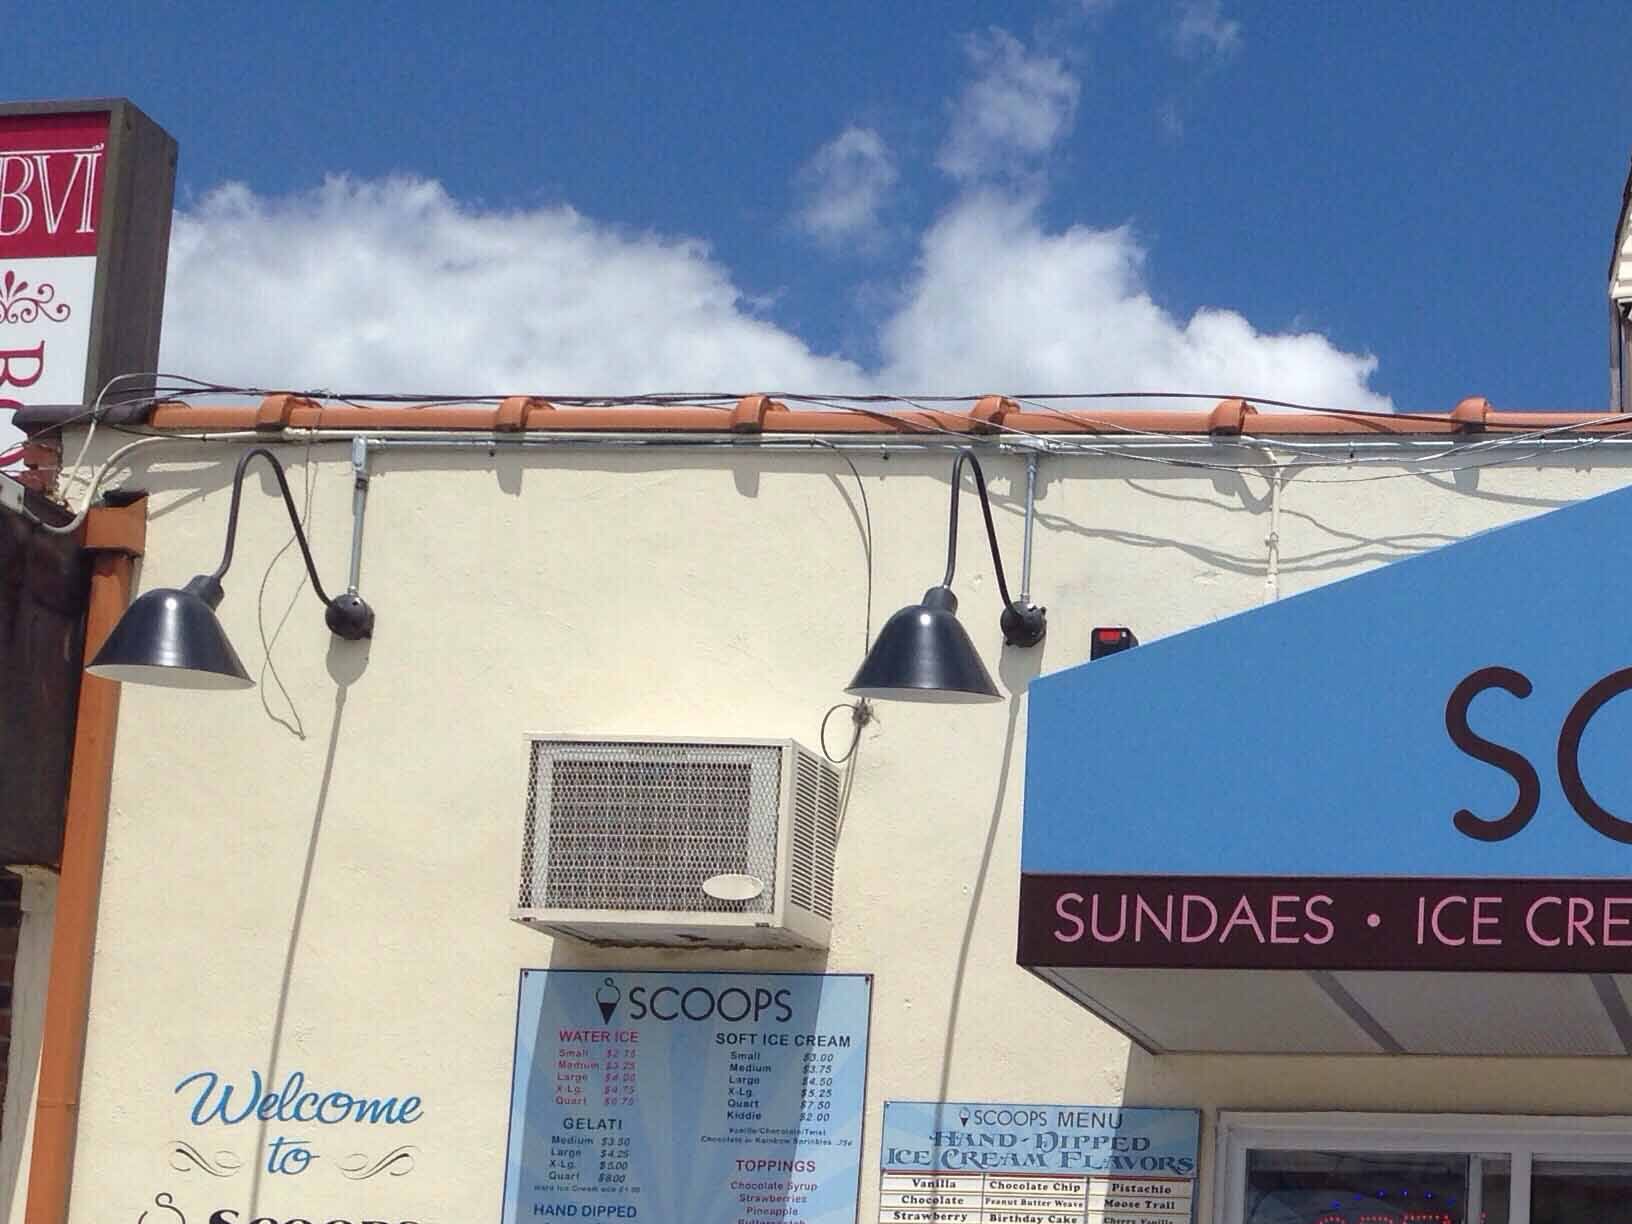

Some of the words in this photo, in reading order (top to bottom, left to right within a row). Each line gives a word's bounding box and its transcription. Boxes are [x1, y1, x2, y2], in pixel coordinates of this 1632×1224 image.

[1053, 892, 1336, 947] SUNDAES
[1418, 896, 1502, 947] ICE
[629, 986, 793, 1023] SCOOPS
[559, 1029, 611, 1043] WATER
[614, 1030, 641, 1044] ICE
[715, 1032, 759, 1046] SOFT
[762, 1033, 790, 1047] ICE
[794, 1034, 852, 1049] CREAM
[729, 1051, 761, 1061] Small
[729, 1063, 773, 1073] Medium
[173, 1069, 425, 1127] Welcome
[563, 1117, 624, 1131] GELATI
[974, 1110, 1048, 1128] SCOOPS
[1057, 1111, 1123, 1129] MENU
[267, 1136, 320, 1176] to
[888, 1148, 931, 1166] ICE
[940, 1148, 1048, 1170] CREAM
[1060, 1151, 1194, 1176] FLAVORS
[735, 1160, 817, 1173] TOPPINGS
[730, 1180, 784, 1191] Chocolate
[787, 1181, 818, 1193] Syrup
[912, 1177, 957, 1189] Vanilla
[990, 1181, 1048, 1192] Chocolate
[1053, 1182, 1081, 1194] Chip
[1112, 1183, 1172, 1195] Pistachio
[901, 1195, 965, 1206] Chocolate
[533, 1204, 578, 1217] HAND
[581, 1204, 638, 1219] DIPPED
[893, 1210, 968, 1223] Strawberry
[1047, 1215, 1078, 1224] Cake
